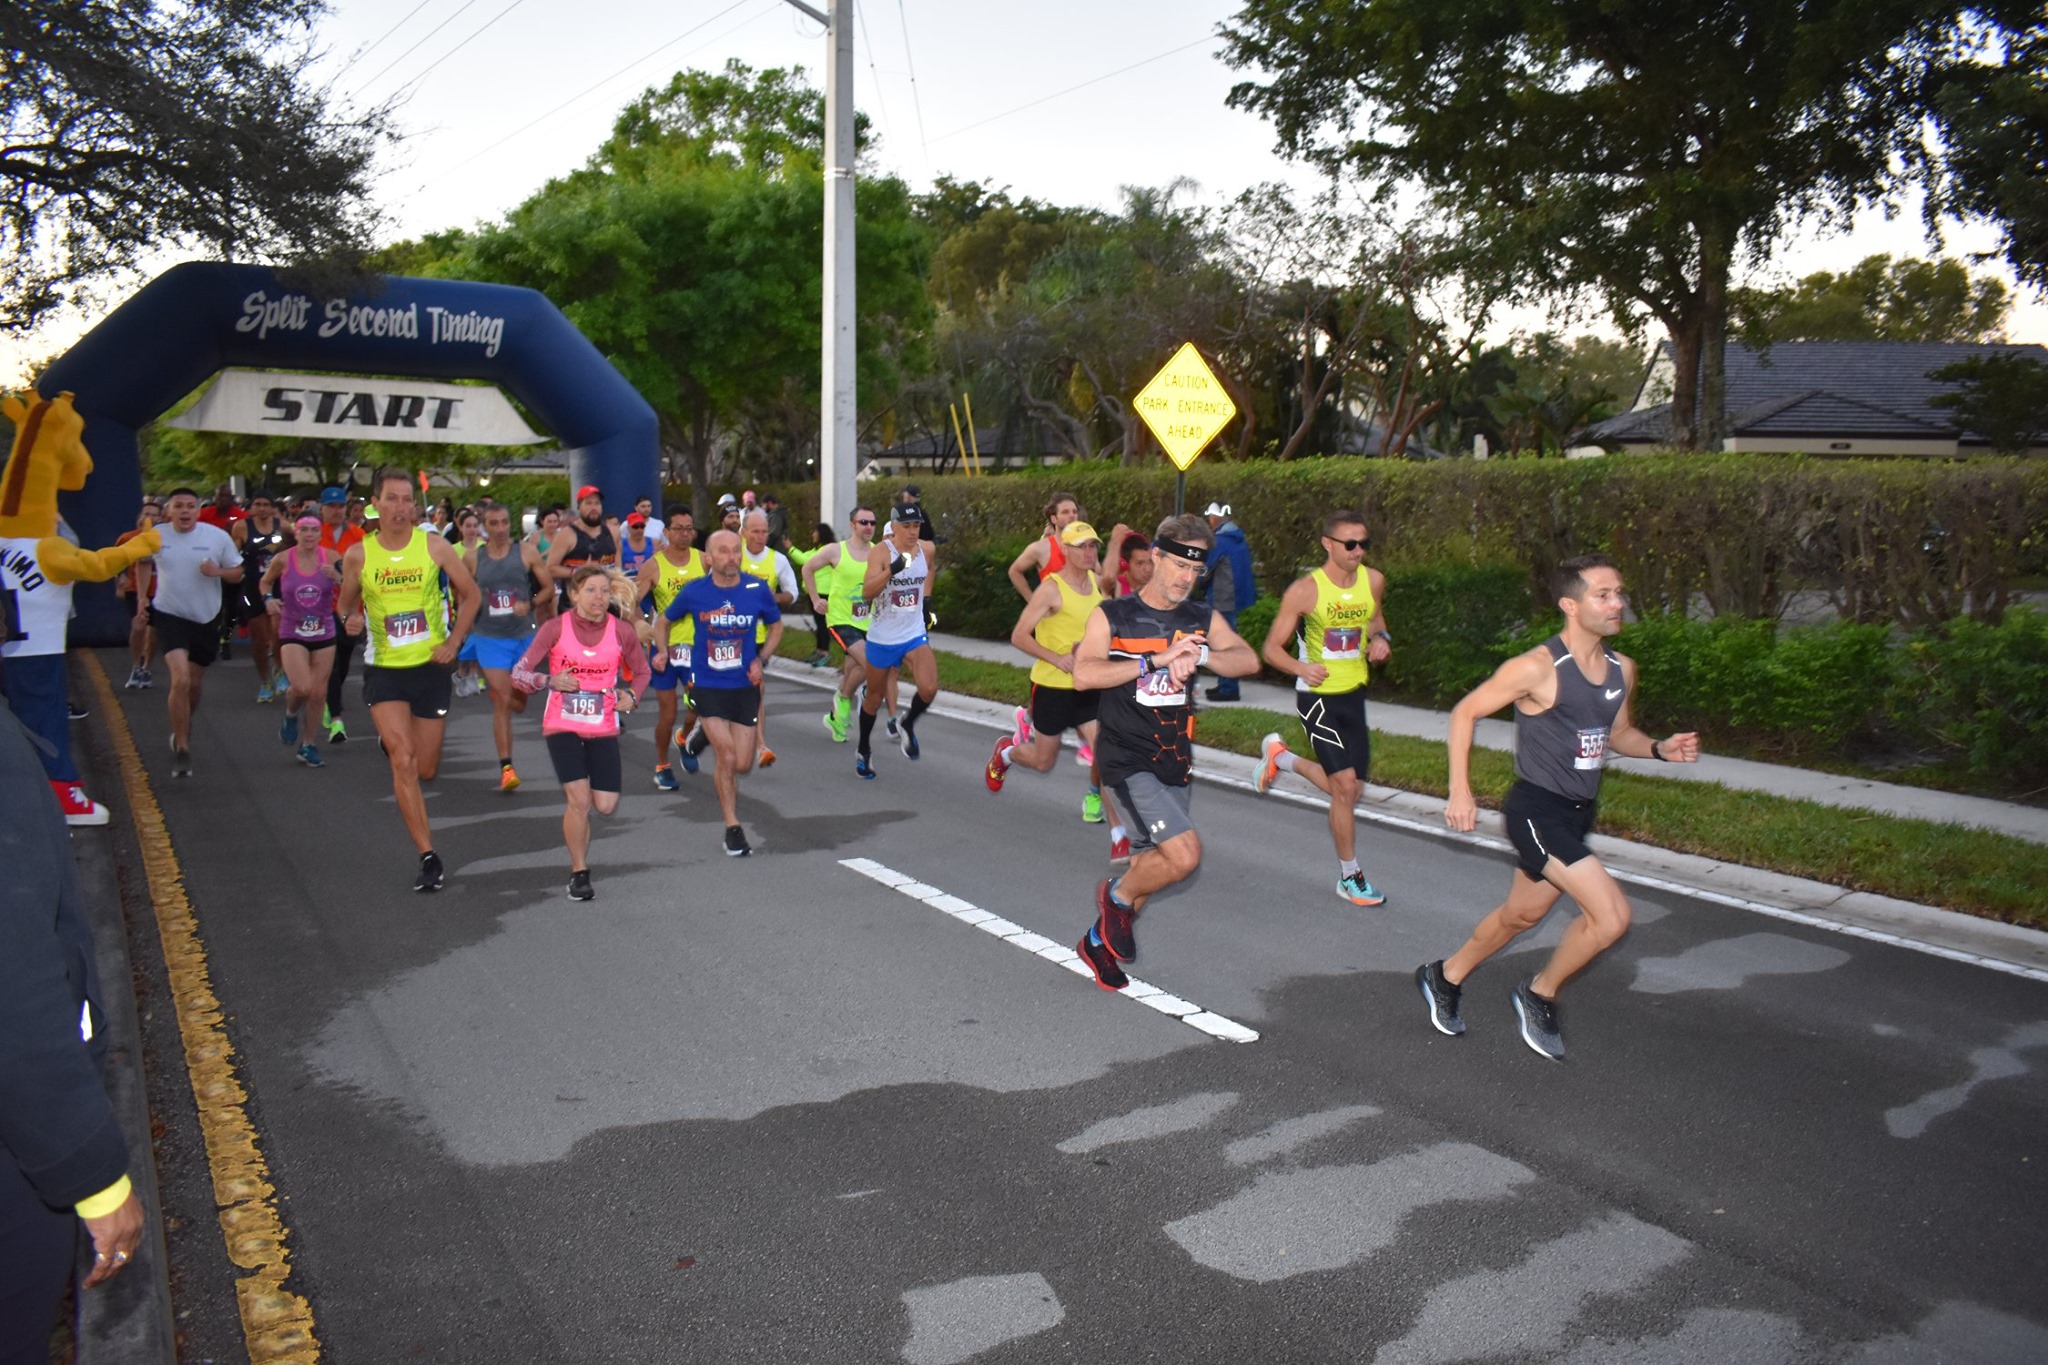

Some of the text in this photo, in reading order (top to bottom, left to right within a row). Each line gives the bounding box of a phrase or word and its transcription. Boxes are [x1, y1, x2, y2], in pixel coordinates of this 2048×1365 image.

[235, 290, 505, 358] Split Second Timing
[1164, 373, 1209, 390] CAUTION
[261, 387, 464, 429] START
[1142, 396, 1229, 416] PARK ENTRANCE
[1167, 425, 1203, 440] AHEAD
[387, 574, 423, 585] DEPOT
[497, 595, 510, 608] 10
[899, 594, 915, 607] 983
[710, 614, 754, 627] DEPOT
[1338, 609, 1368, 619] DEPOT
[302, 619, 320, 631] 439
[394, 617, 418, 637] 727
[1341, 635, 1347, 650] 1
[714, 645, 735, 661] 830
[571, 698, 596, 715] 195
[1581, 733, 1605, 757] 555
